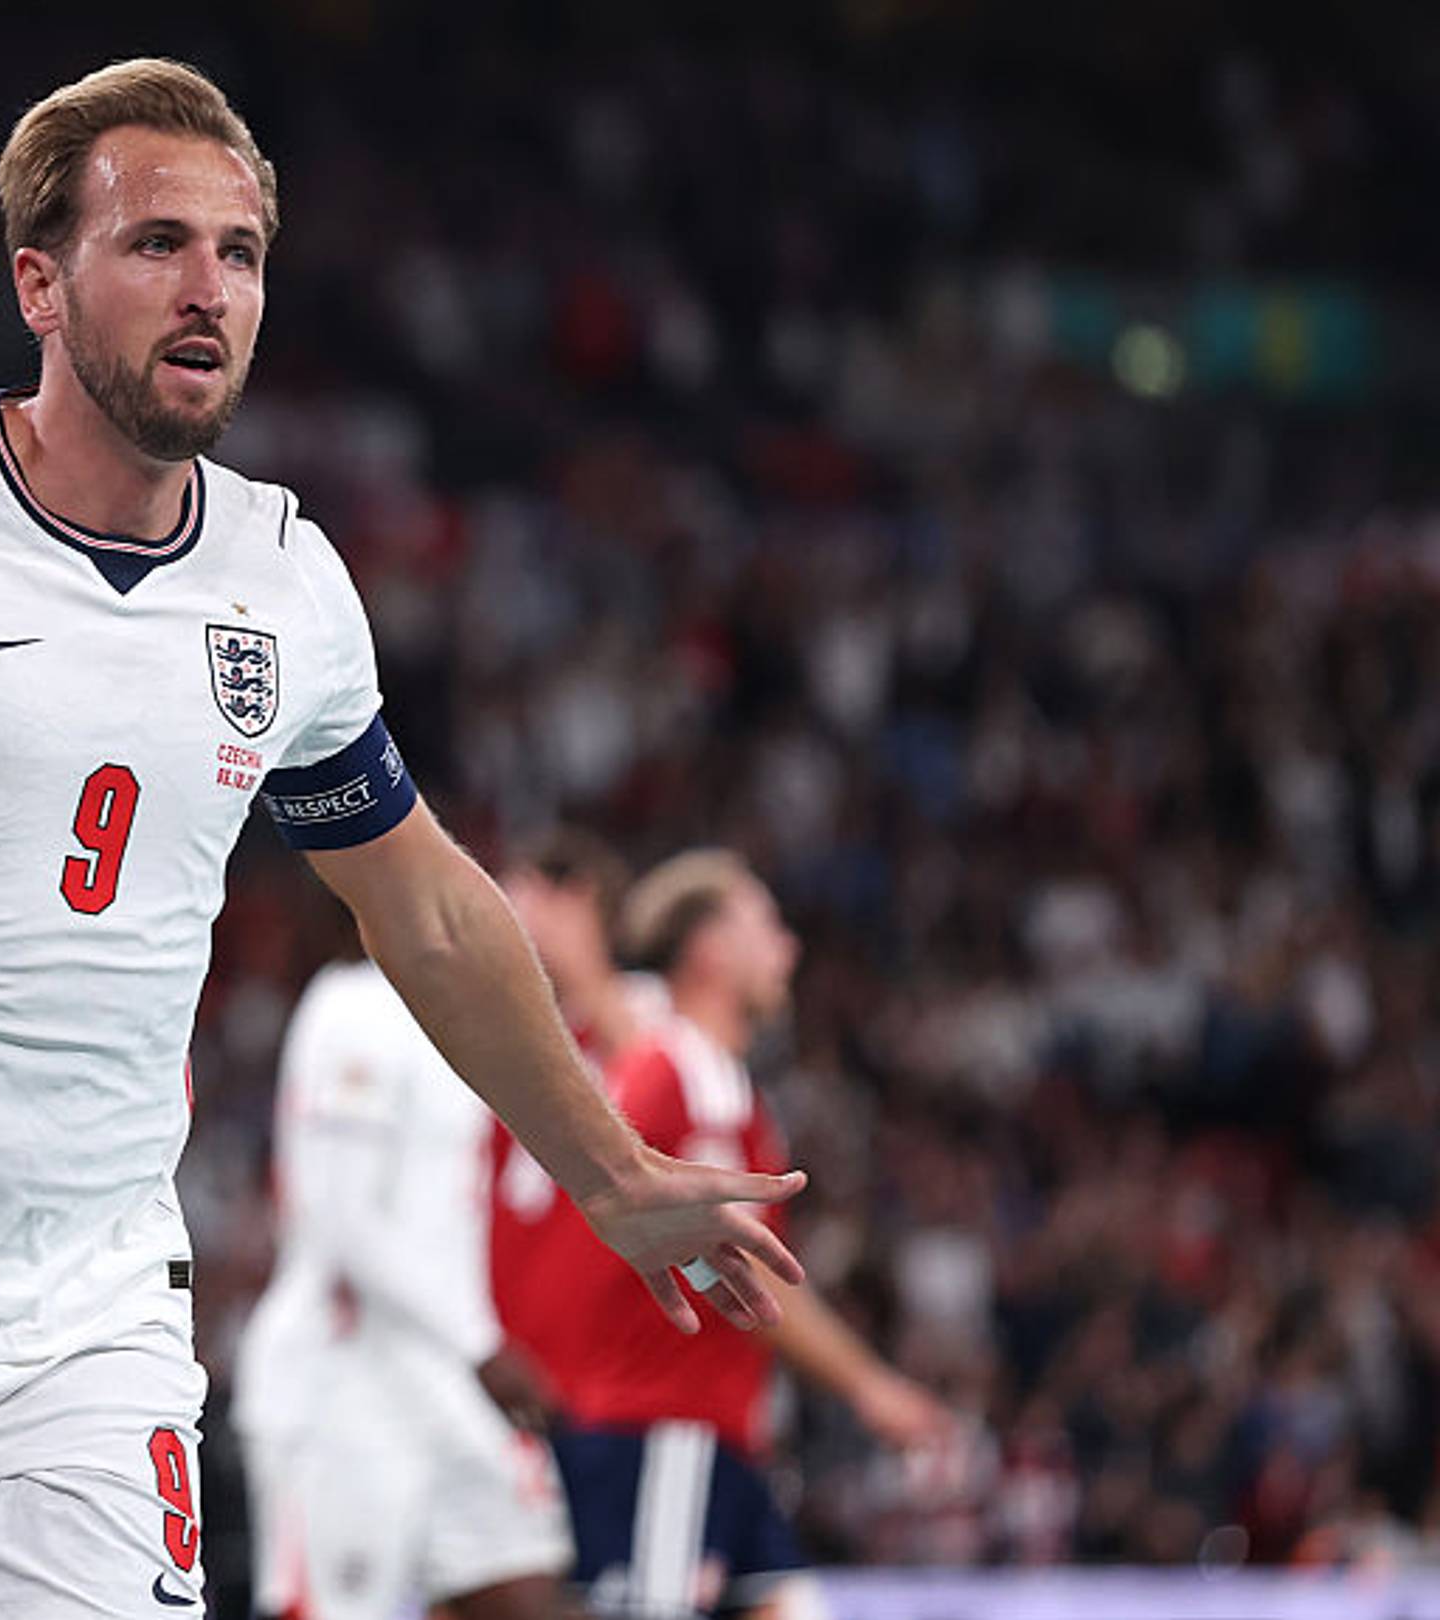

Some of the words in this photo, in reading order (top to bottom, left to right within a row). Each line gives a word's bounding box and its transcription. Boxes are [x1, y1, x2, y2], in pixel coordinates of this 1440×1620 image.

[60, 763, 141, 915] 9
[283, 780, 370, 818] RESPECT
[147, 1427, 200, 1574] 9
